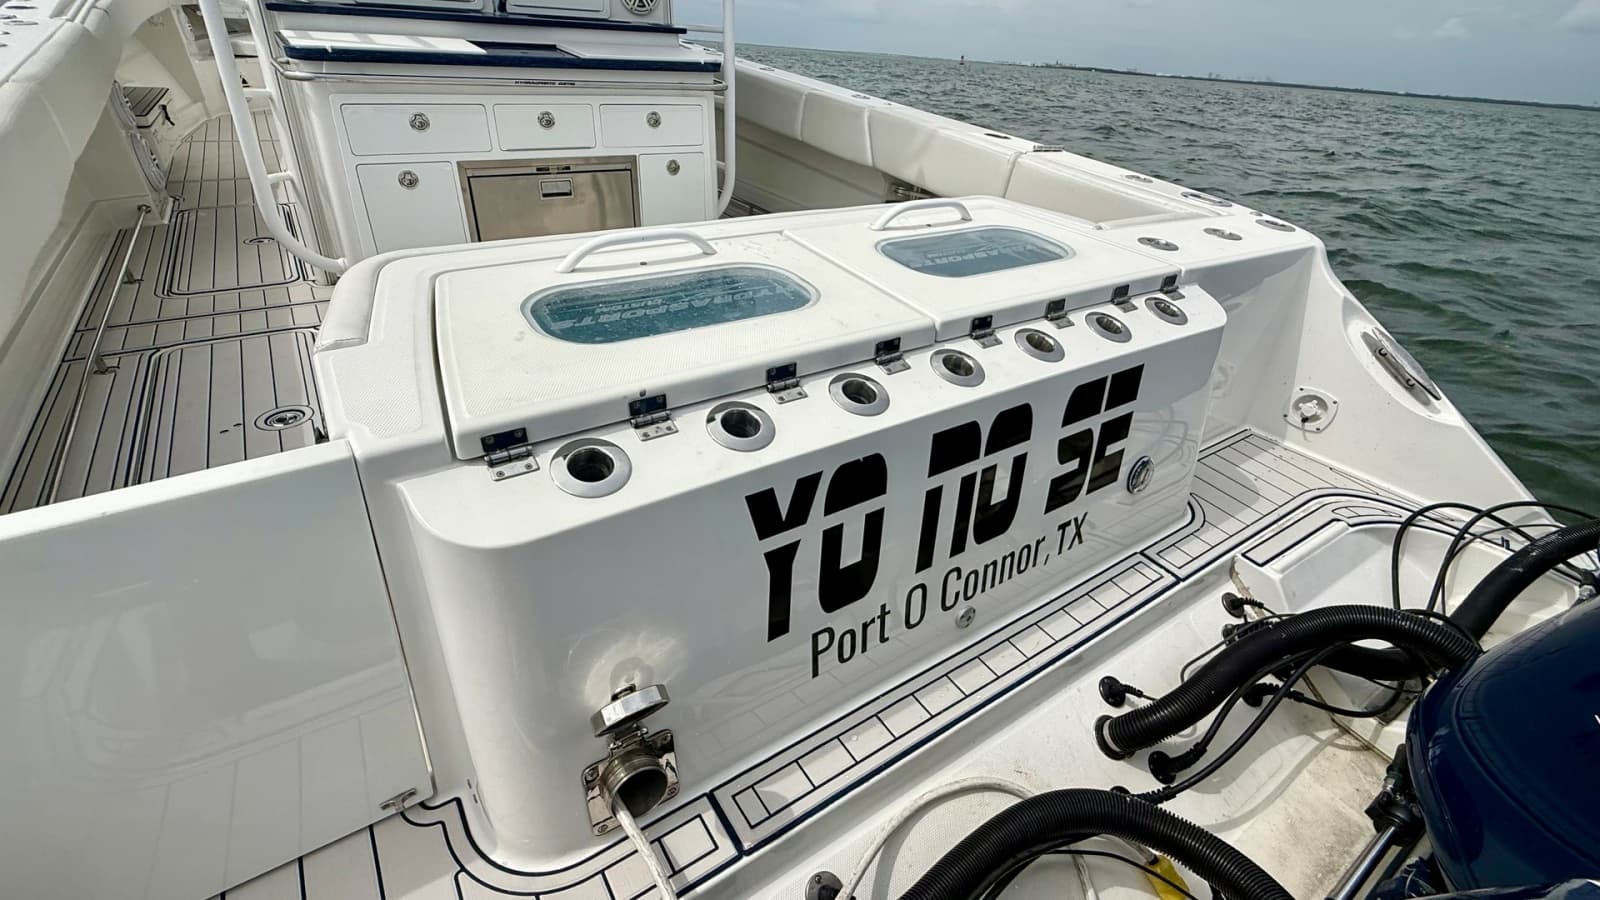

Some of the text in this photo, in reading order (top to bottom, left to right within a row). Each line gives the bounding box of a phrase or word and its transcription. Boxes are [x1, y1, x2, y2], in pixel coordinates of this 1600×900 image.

[744, 363, 1145, 643] YO NO SE
[811, 511, 1088, 679] Port O Connor, TX
